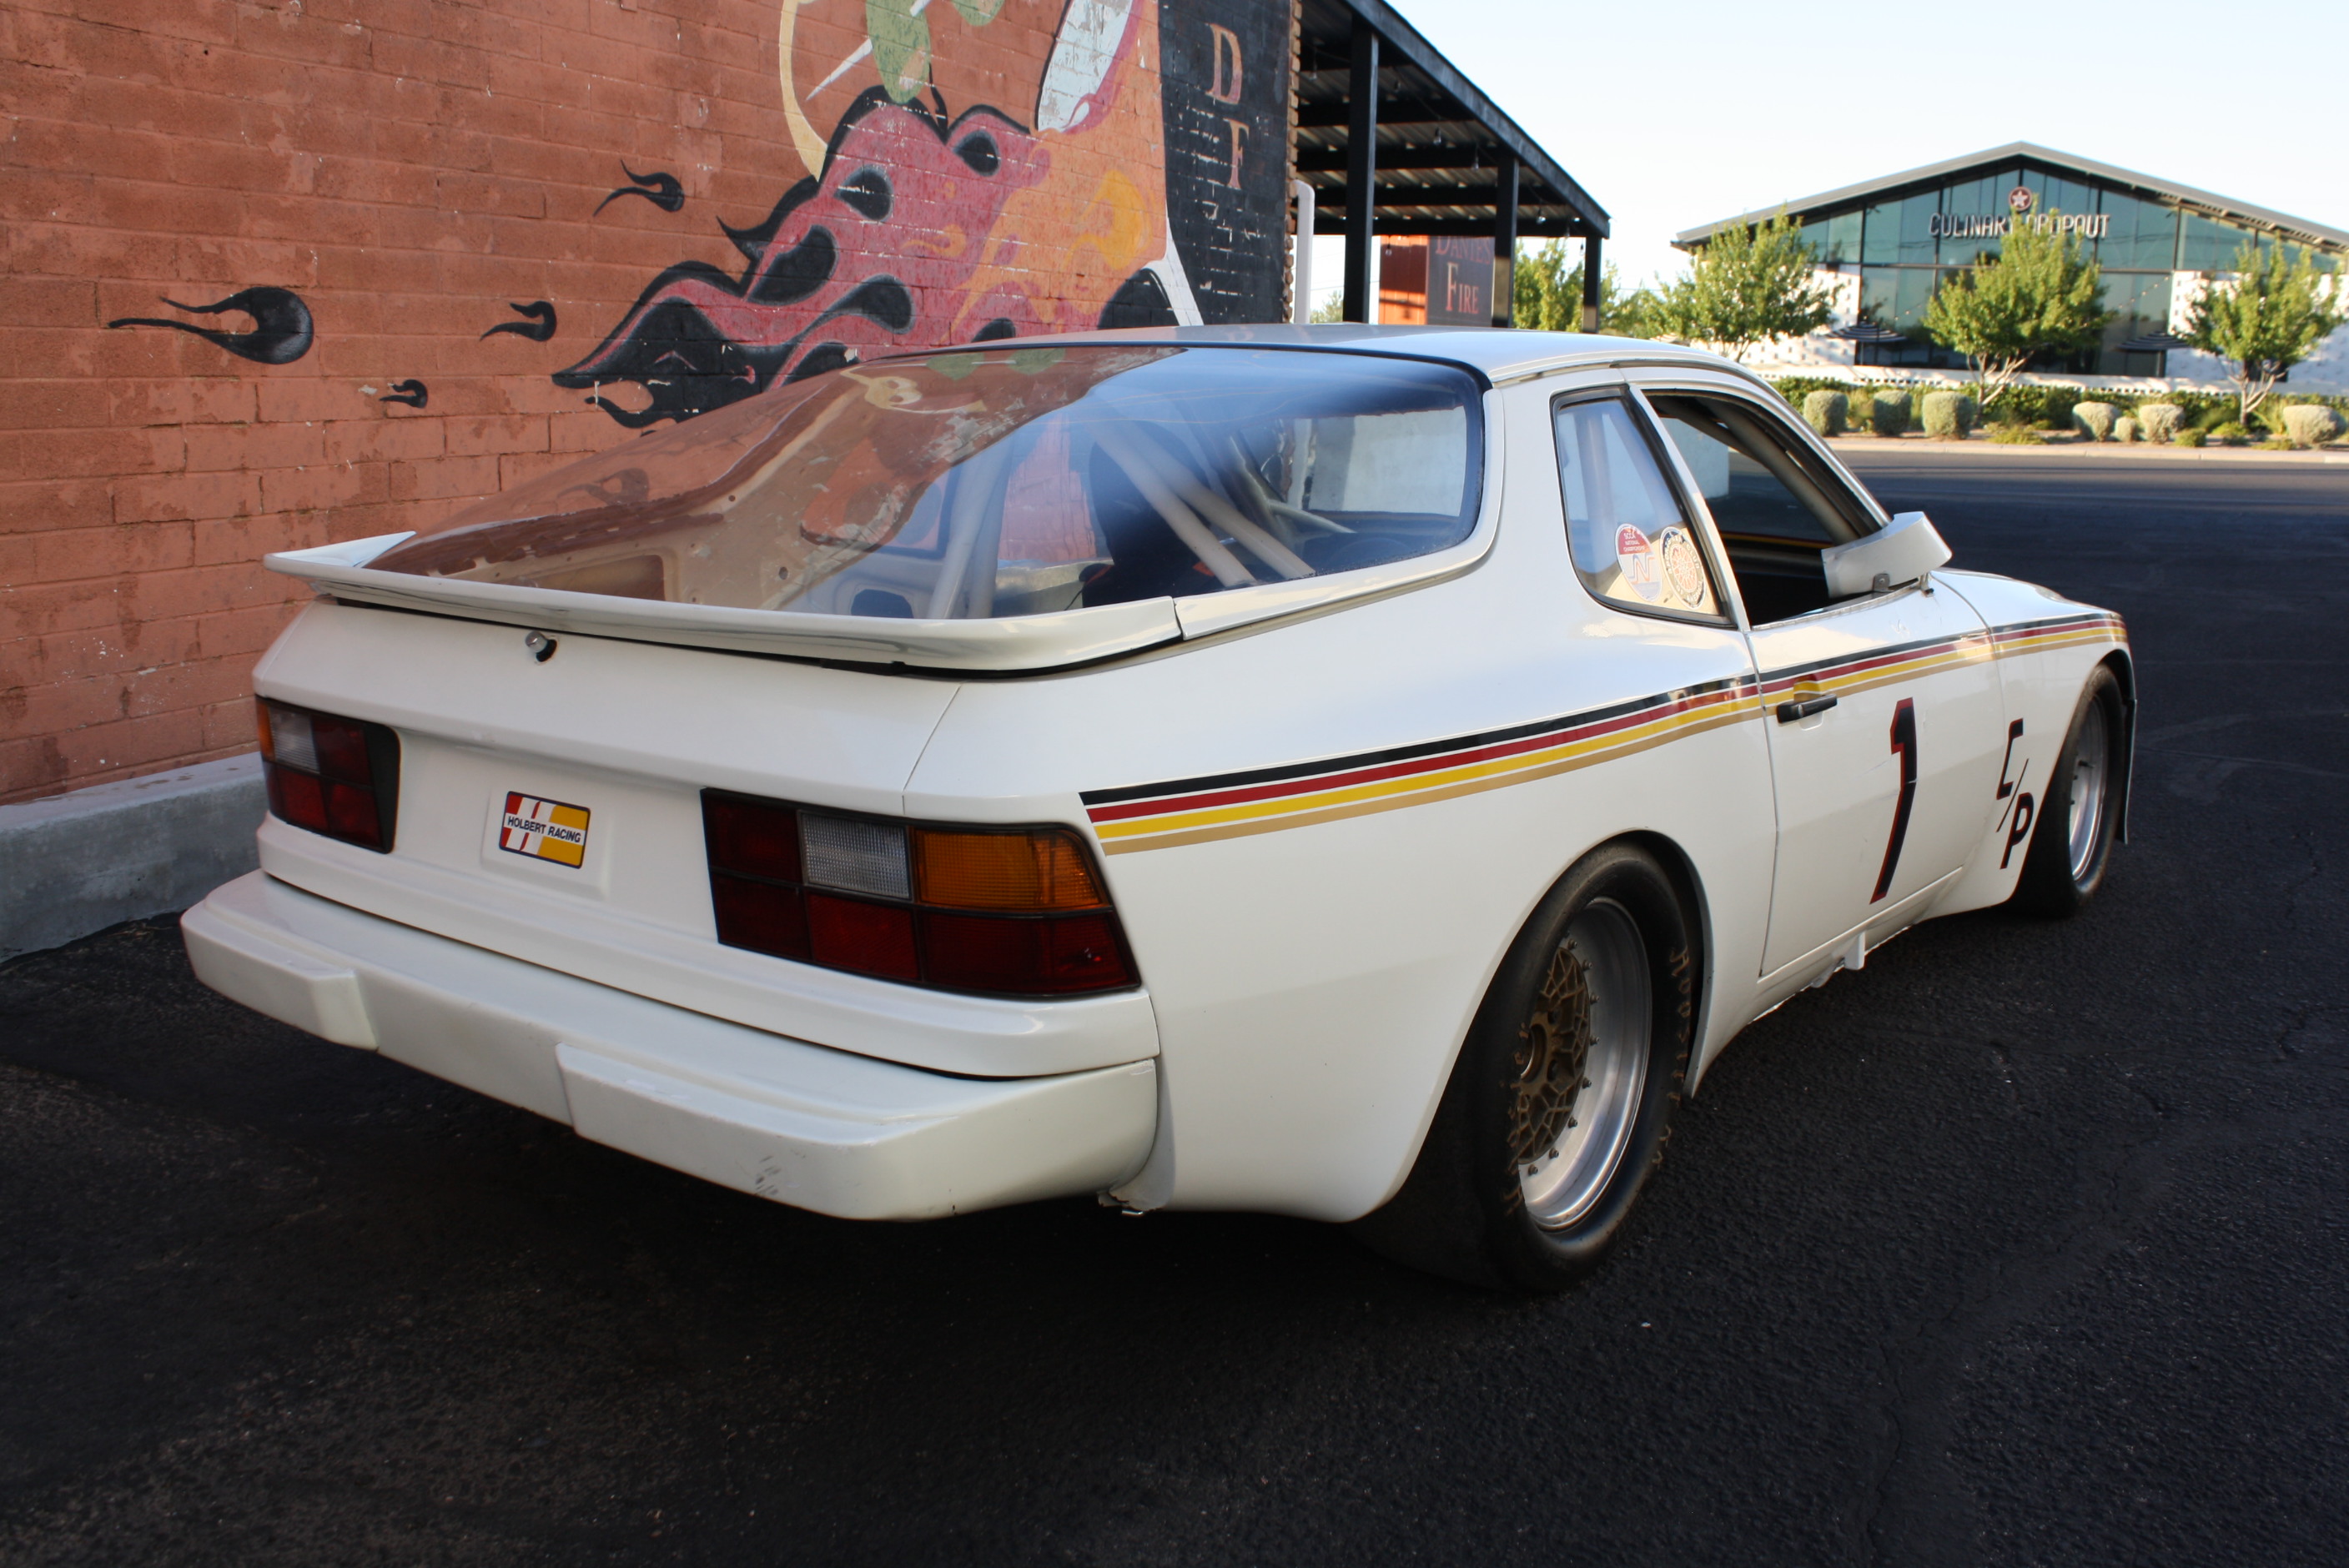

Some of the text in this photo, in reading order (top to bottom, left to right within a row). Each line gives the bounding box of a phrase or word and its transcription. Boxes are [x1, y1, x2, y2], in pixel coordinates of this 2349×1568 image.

[1205, 23, 1243, 105] D
[1223, 117, 1250, 190] F
[1446, 261, 1479, 314] FIRE
[507, 816, 581, 843] HOLBERT RACING
[1869, 696, 1917, 904] 1
